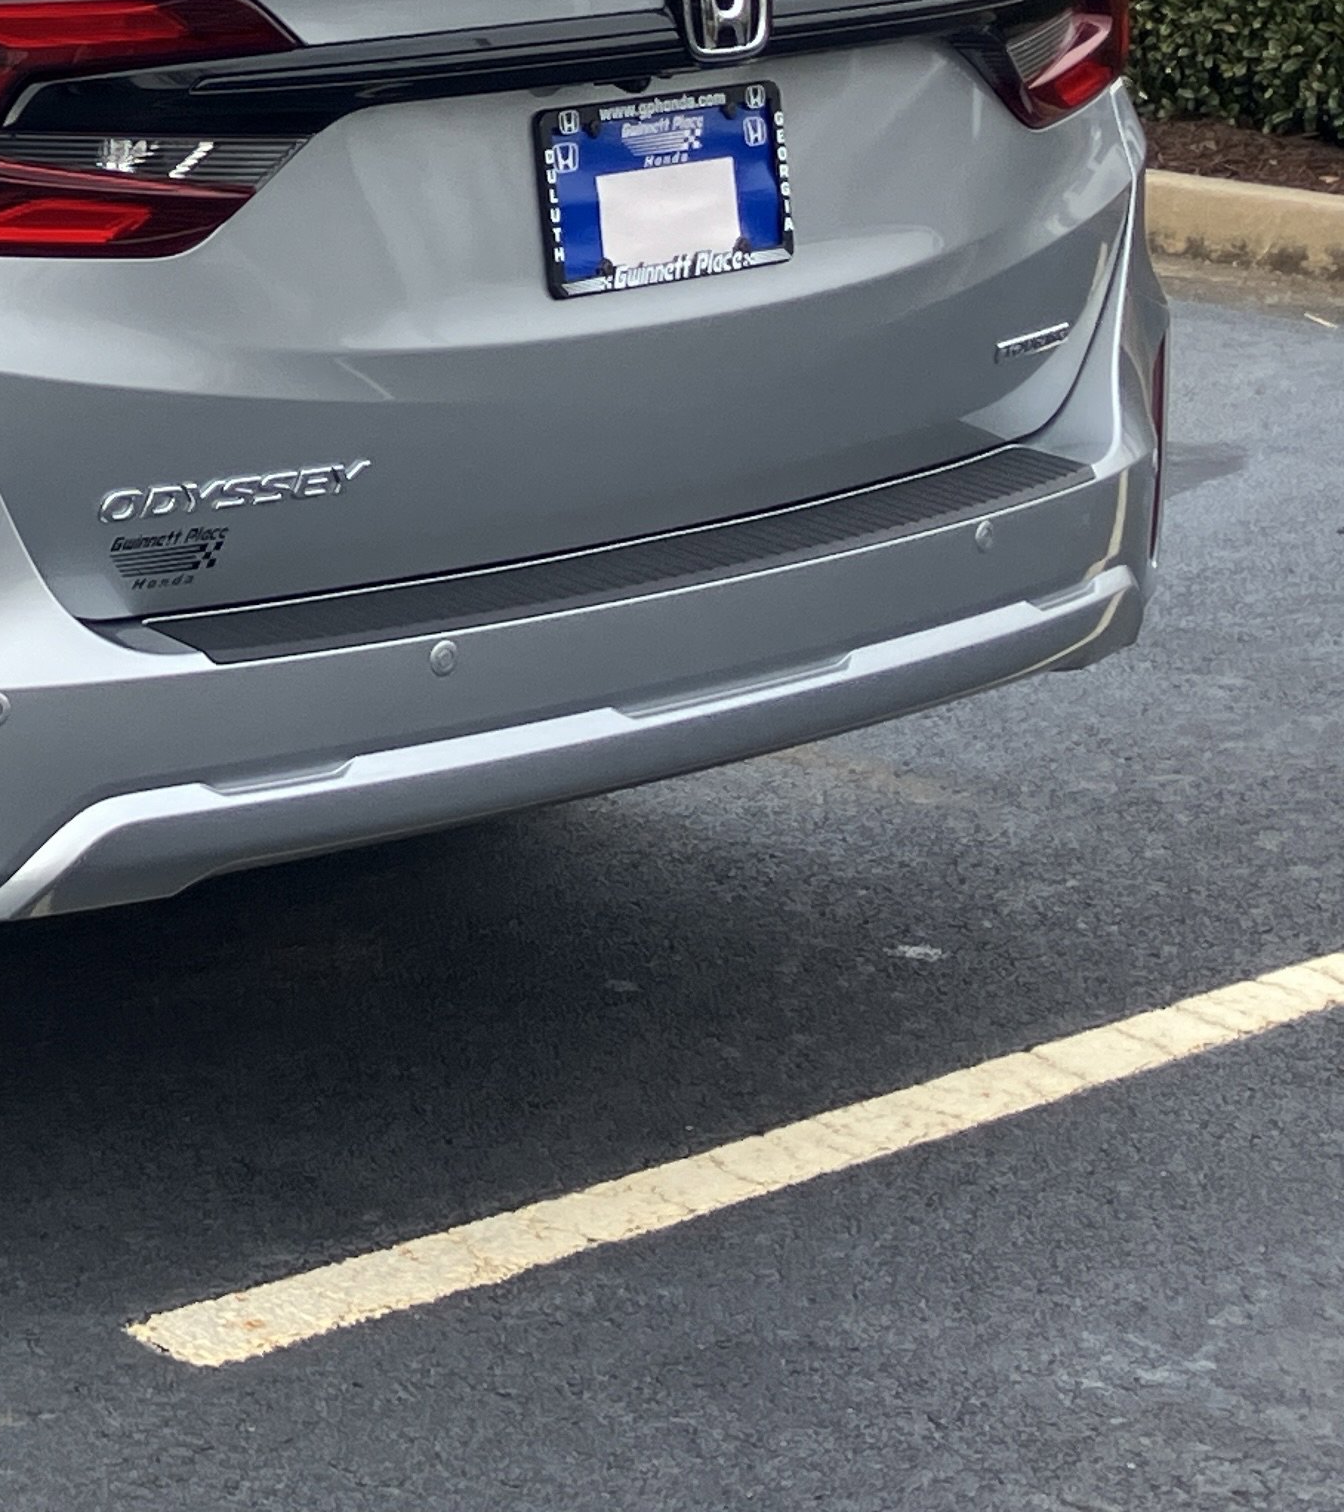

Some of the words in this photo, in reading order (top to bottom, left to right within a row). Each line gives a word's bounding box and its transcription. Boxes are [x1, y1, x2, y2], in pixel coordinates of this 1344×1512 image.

[598, 93, 727, 121] www.gphonda.com
[644, 150, 689, 168] Honda
[773, 110, 795, 232] GEORGIA
[544, 149, 565, 262] DULUTH
[614, 254, 692, 289] Gwinnett
[694, 249, 742, 277] Place
[98, 457, 372, 523] ODYSSEY
[131, 573, 195, 590] Honda
